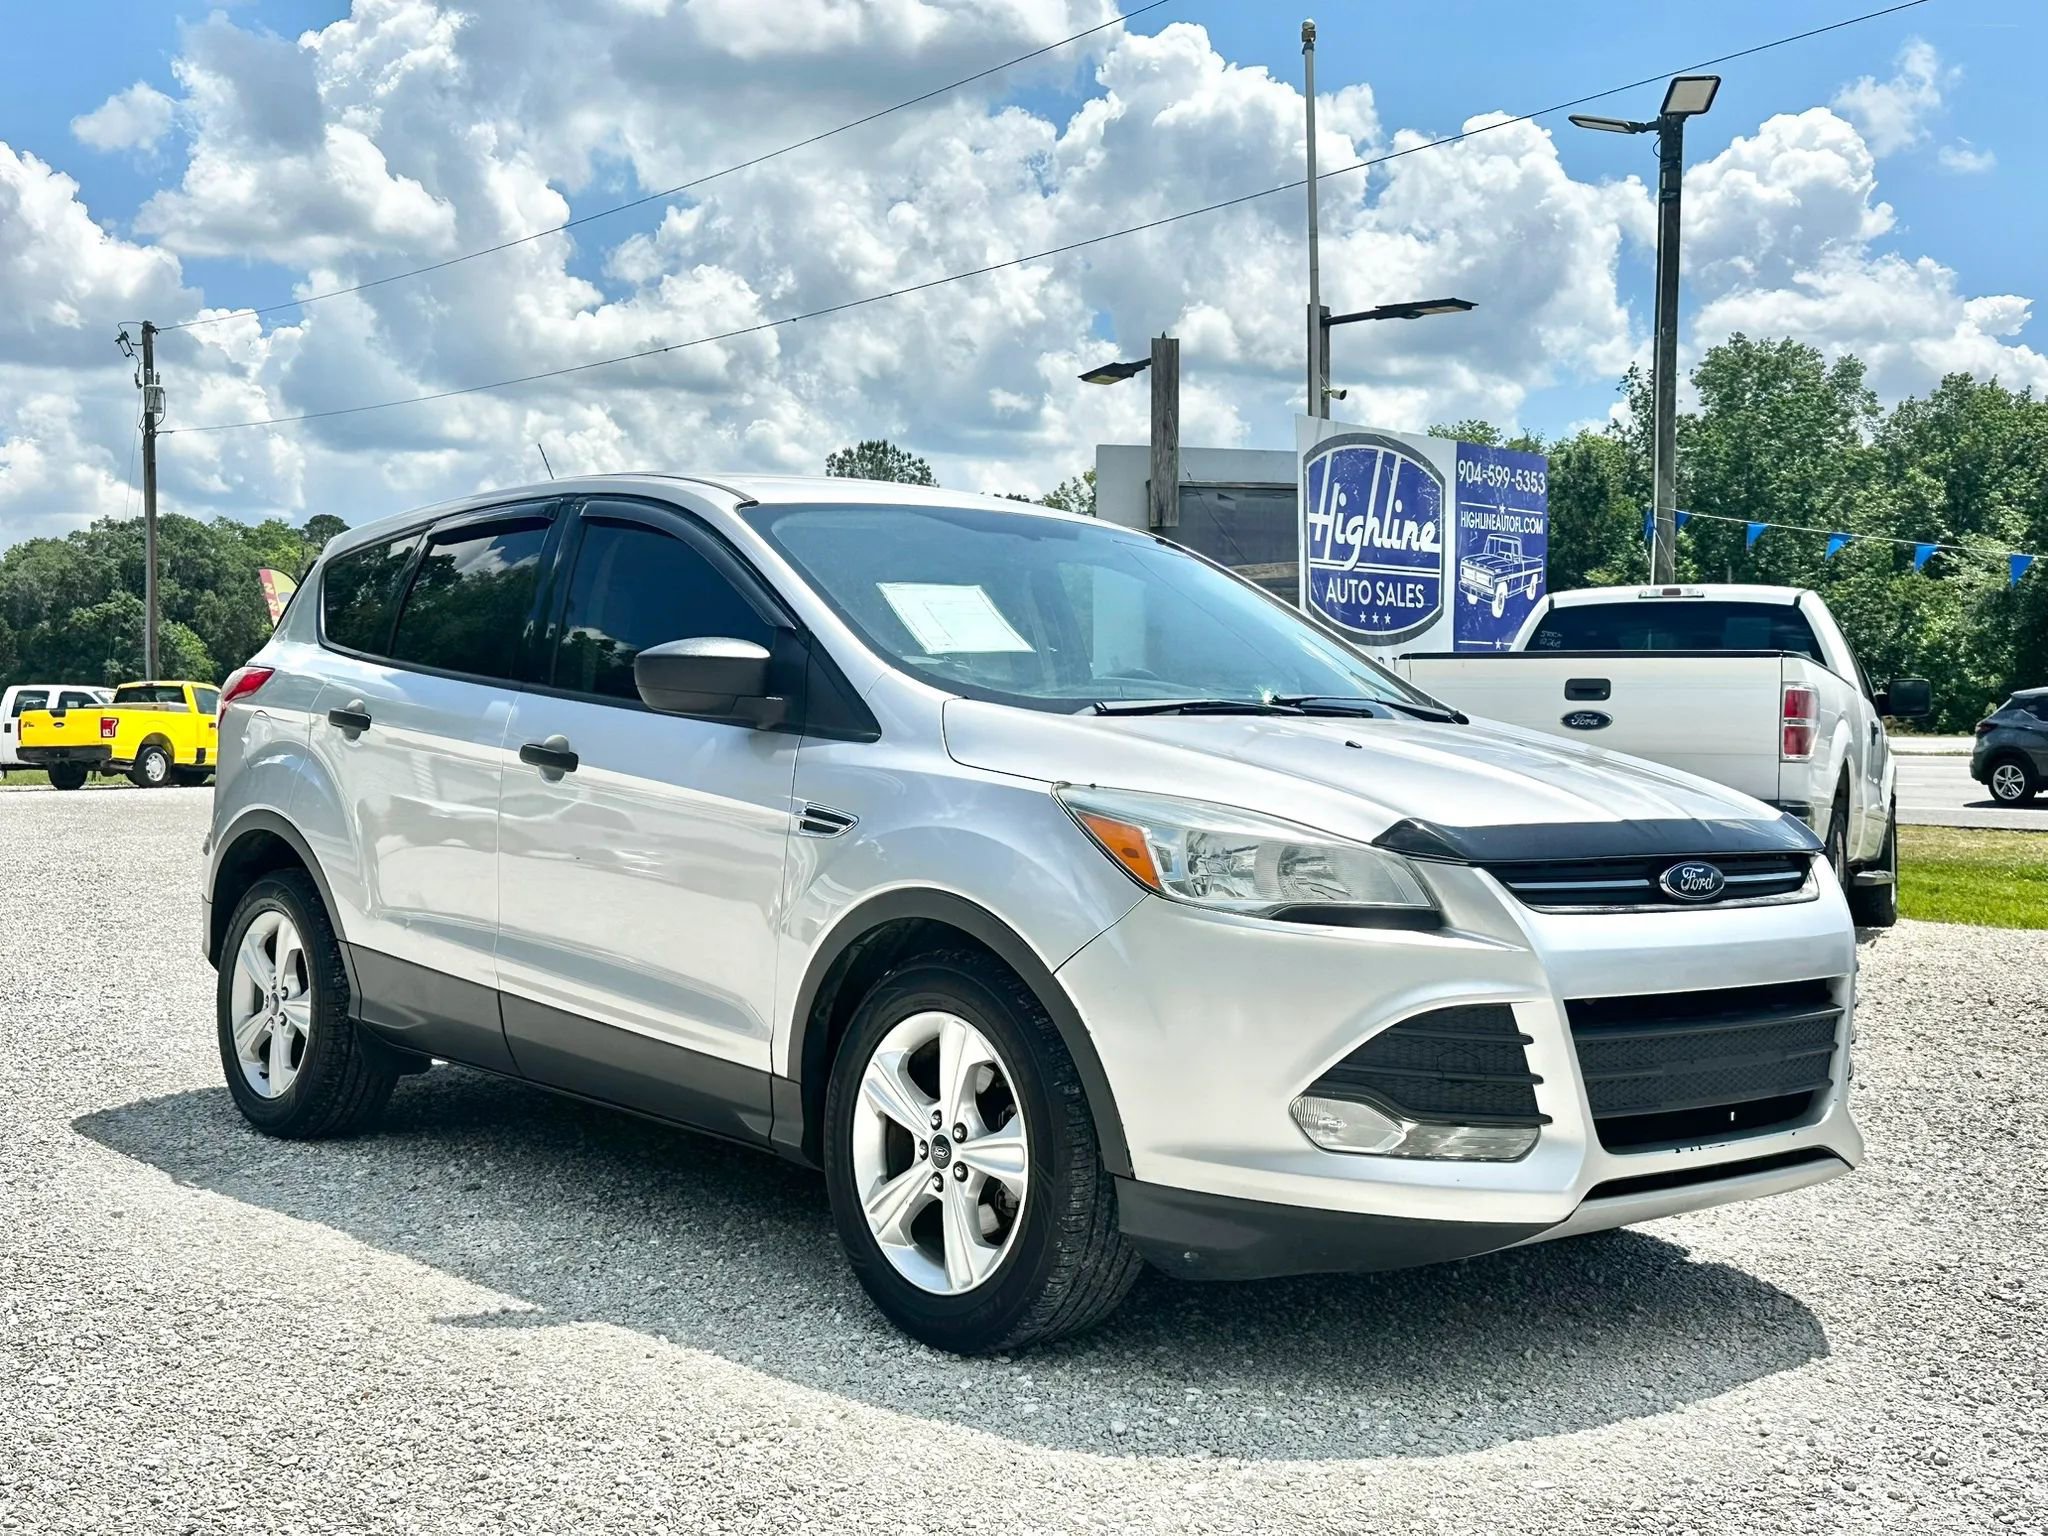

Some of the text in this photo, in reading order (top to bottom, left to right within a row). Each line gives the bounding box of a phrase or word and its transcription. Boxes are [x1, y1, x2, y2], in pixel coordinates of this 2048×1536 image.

[1458, 459, 1546, 495] 904-599-5353
[1308, 449, 1441, 571] Highline
[1460, 511, 1544, 535] HIGHLINEAUTOFL.COM
[1326, 577, 1424, 608] AUTO SALES
[1571, 713, 1600, 725] Ford
[1680, 867, 1715, 891] Ford
